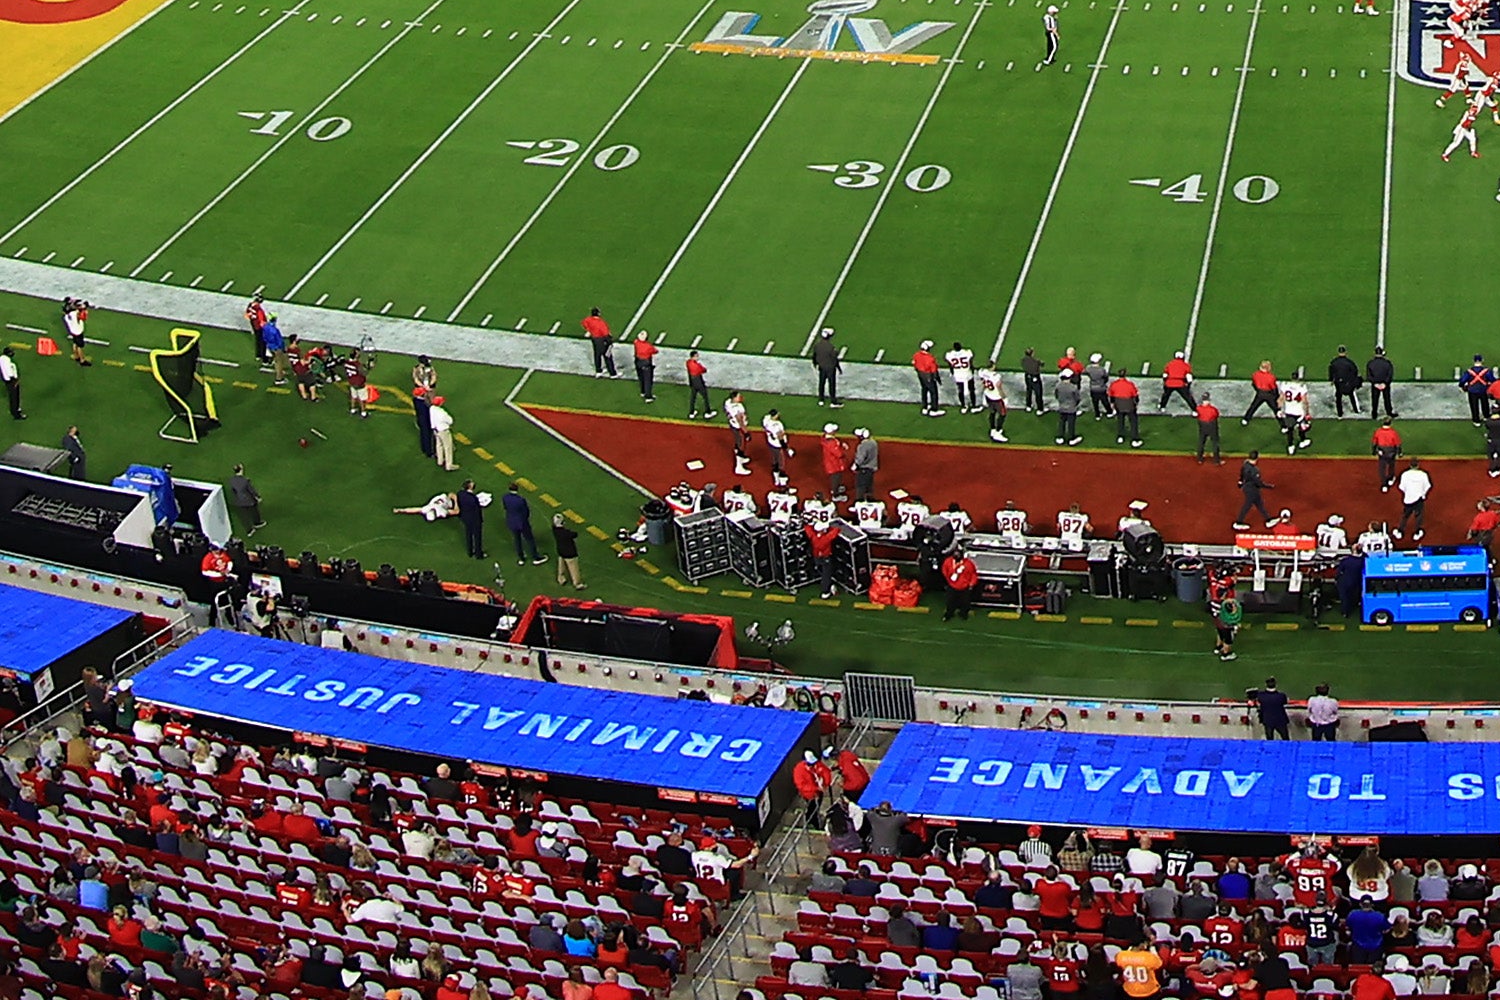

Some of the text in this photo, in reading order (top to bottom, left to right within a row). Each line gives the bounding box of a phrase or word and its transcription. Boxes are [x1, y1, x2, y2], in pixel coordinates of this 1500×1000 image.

[249, 109, 353, 141] 10
[523, 138, 641, 172] 20
[833, 159, 953, 193] 30
[1160, 173, 1281, 205] 40
[950, 356, 970, 369] 25
[1283, 389, 1304, 403] 84
[770, 500, 789, 514] 74
[859, 507, 879, 521] 64
[902, 512, 921, 526] 78
[1001, 517, 1020, 531] 28
[1062, 517, 1082, 533] 87
[173, 653, 764, 763] CRIMINAL JUSTICE
[928, 755, 1265, 799] ADVANCE
[1306, 772, 1388, 801] TO
[695, 862, 714, 880] 12
[1166, 859, 1186, 877] 87
[1310, 922, 1329, 939] 12
[1121, 966, 1149, 984] 40
